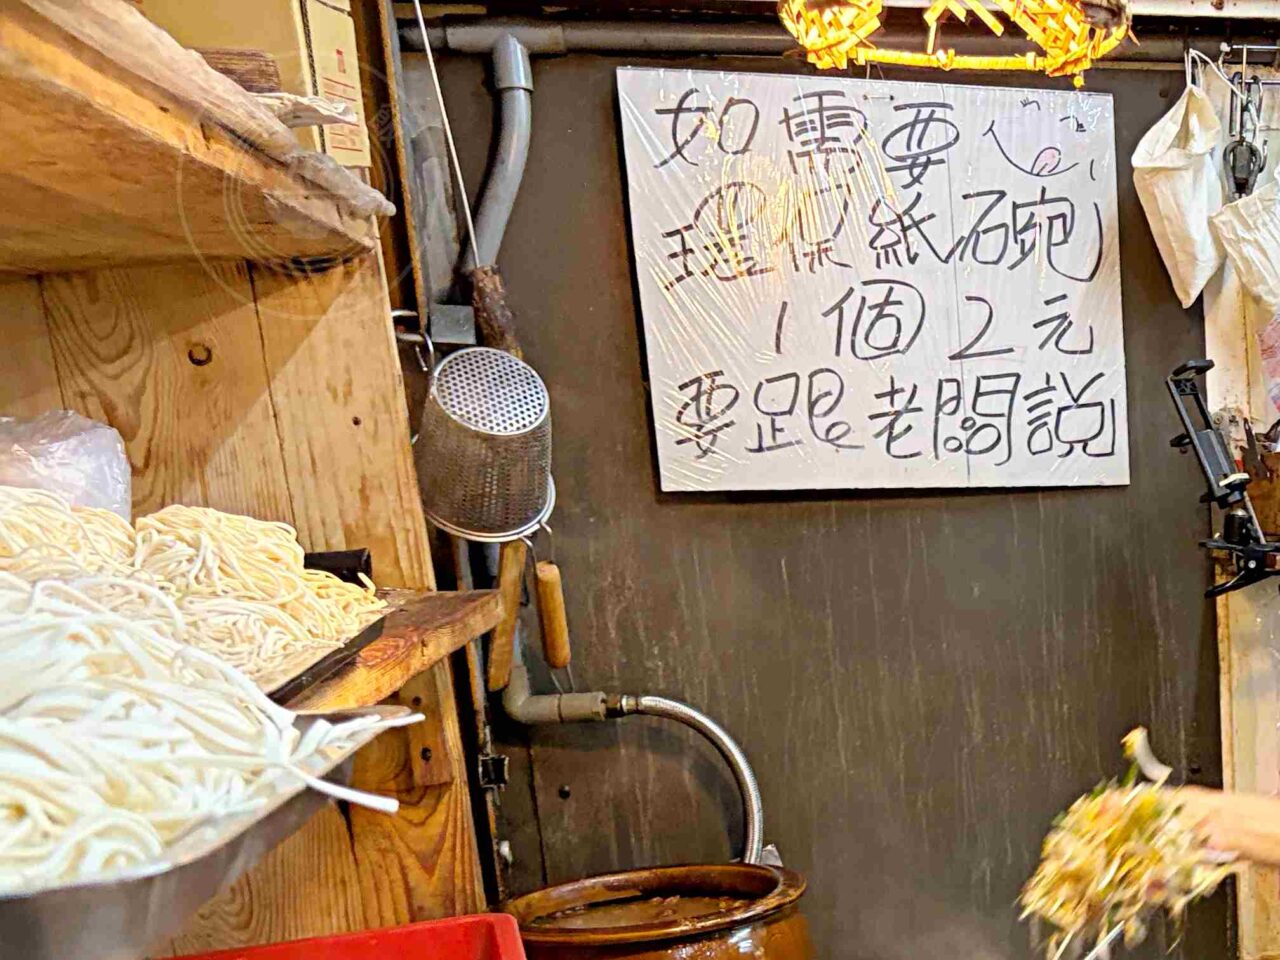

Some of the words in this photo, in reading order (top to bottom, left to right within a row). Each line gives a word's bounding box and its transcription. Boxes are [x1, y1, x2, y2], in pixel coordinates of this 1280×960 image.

[654, 87, 960, 187] 如需要
[674, 367, 1115, 466] 要跟老闆說
